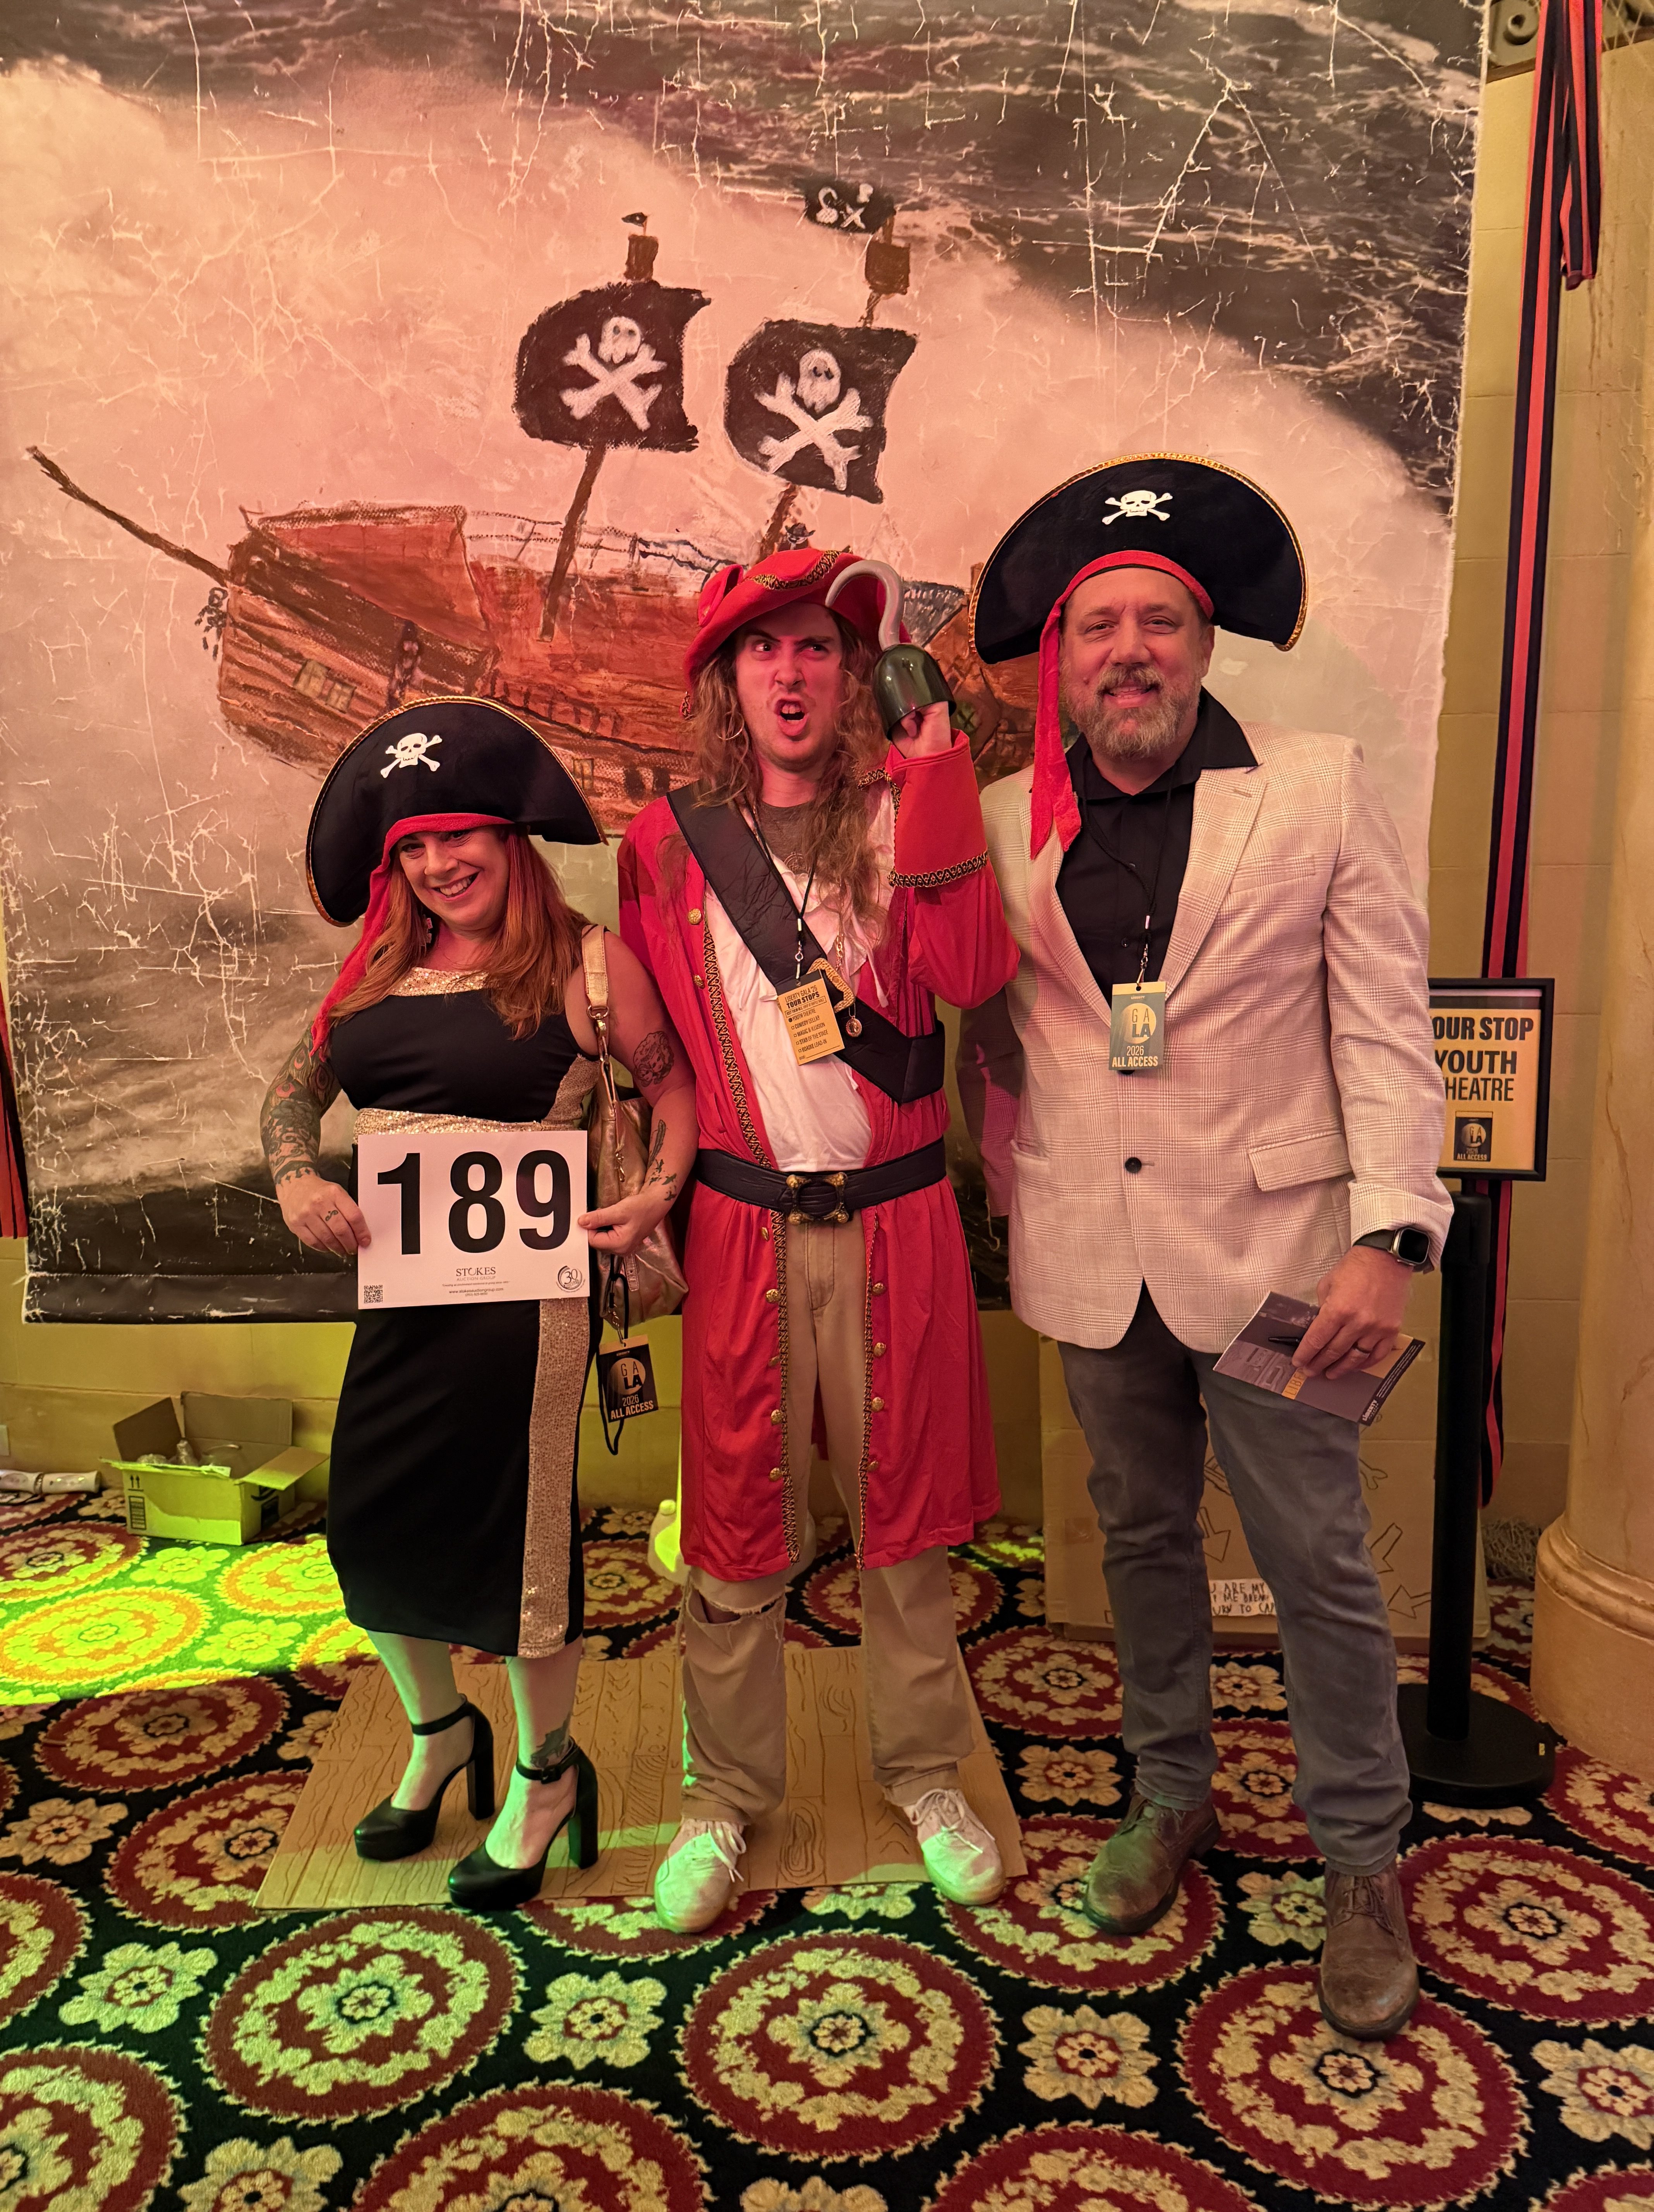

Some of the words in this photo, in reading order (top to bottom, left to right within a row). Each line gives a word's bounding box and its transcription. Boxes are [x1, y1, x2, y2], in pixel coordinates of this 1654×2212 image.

[785, 991, 800, 1002] LIBERTY
[801, 989, 811, 997] GALA
[786, 998, 801, 1009] TOUR
[802, 991, 820, 1003] STOPS
[793, 1013, 803, 1021] YOUTH
[794, 1020, 808, 1029] COMEDY
[1430, 1016, 1475, 1040] OUR
[1479, 1017, 1534, 1041] STOP
[1127, 1046, 1144, 1056] 2026
[1112, 1057, 1126, 1067] ALL
[1127, 1056, 1158, 1067] ACCESS
[1434, 1049, 1517, 1074] YOUTH
[377, 1149, 571, 1255] 189
[456, 1267, 496, 1276] STOKES
[564, 1269, 578, 1285] 30
[622, 1394, 639, 1407] 2026
[611, 1409, 625, 1420] ALL
[626, 1400, 654, 1416] ACCESS
[1240, 1605, 1251, 1614] TO
